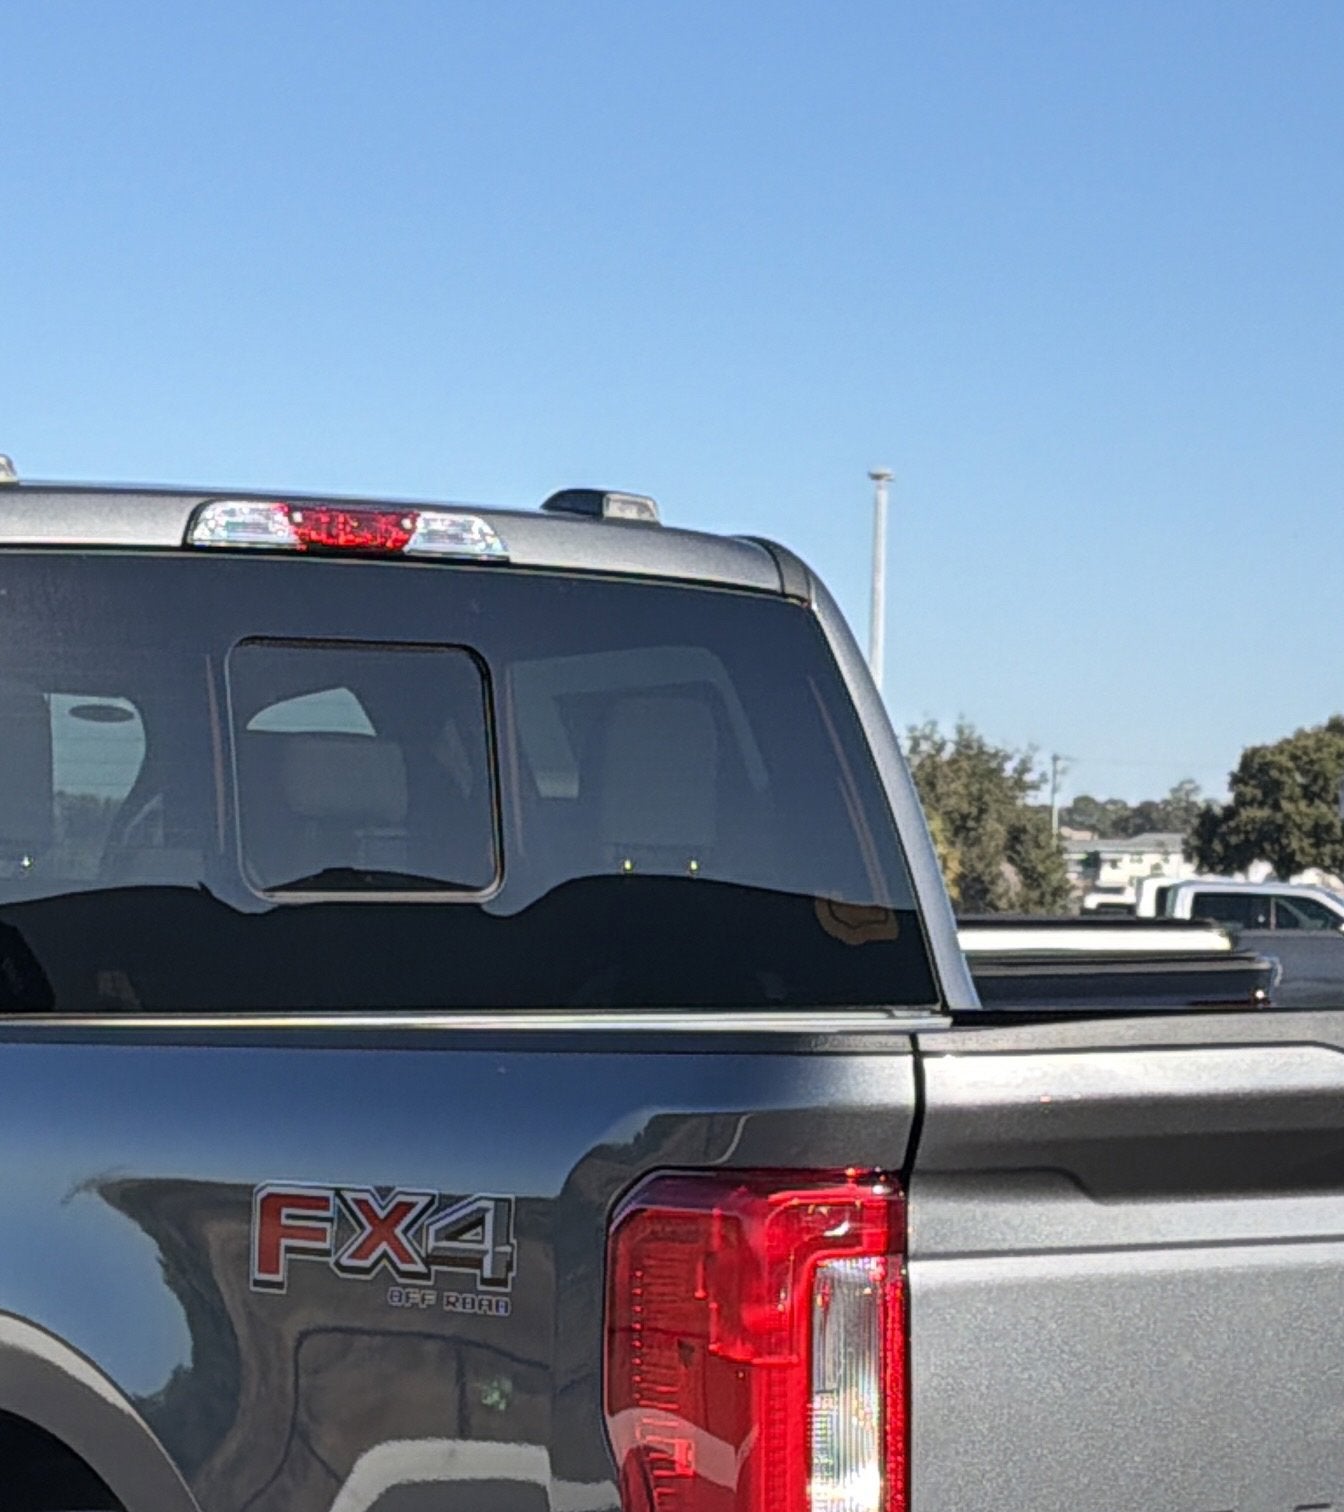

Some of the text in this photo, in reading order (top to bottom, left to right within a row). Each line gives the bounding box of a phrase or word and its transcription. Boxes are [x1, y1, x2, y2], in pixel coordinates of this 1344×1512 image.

[250, 1180, 517, 1294] FX4
[387, 1286, 511, 1317] OFF ROAD
